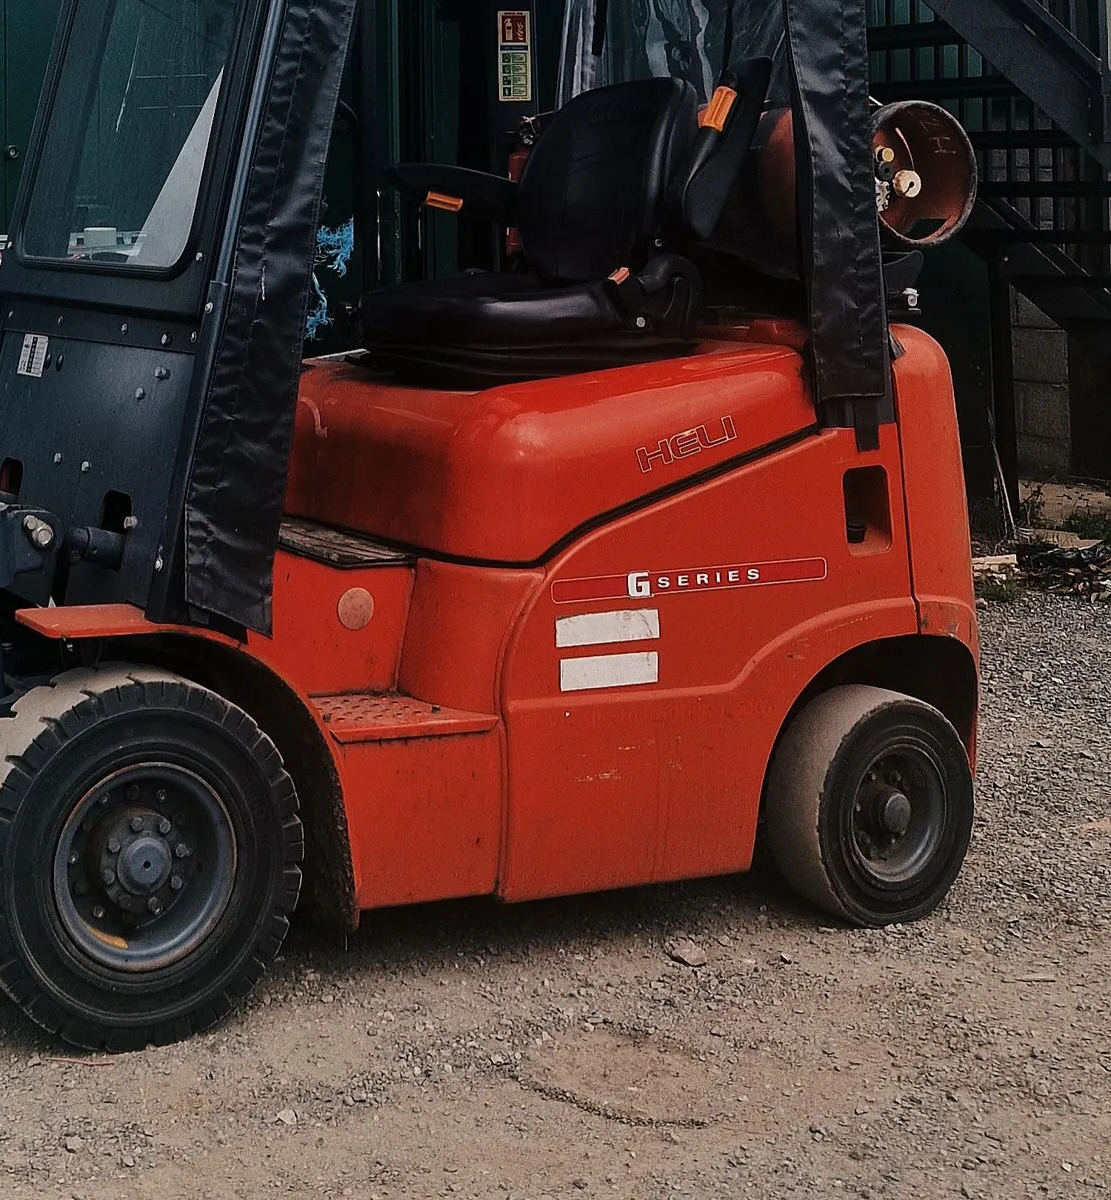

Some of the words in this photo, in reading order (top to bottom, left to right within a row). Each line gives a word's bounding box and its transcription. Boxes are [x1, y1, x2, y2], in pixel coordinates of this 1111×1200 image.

[635, 415, 738, 473] HELI
[627, 571, 652, 598] G
[657, 568, 761, 589] SERIES
